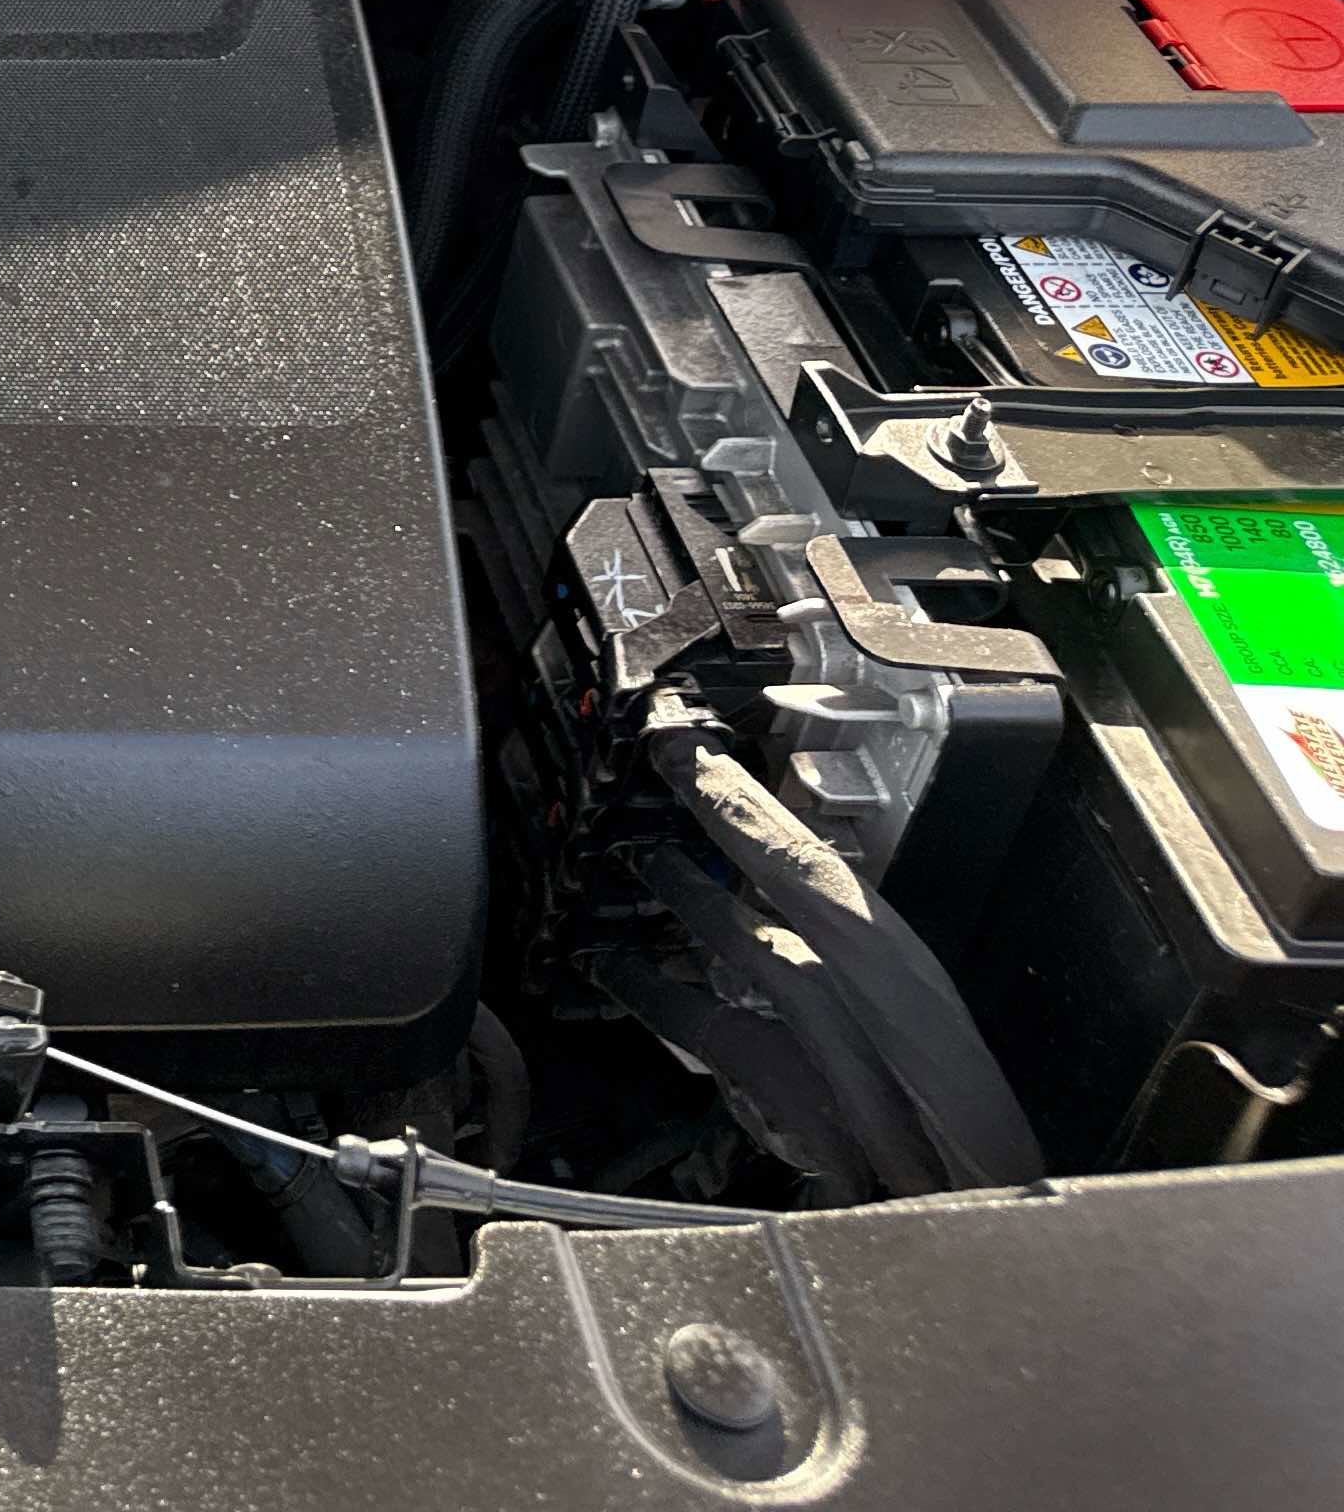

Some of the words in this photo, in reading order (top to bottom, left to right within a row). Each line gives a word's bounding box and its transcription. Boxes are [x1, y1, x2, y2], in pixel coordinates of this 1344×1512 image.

[1233, 343, 1264, 371] Return
[1158, 513, 1179, 535] AGM
[1180, 514, 1213, 544] 850
[1209, 516, 1246, 552] 1000
[1237, 517, 1266, 543] 140
[1264, 519, 1291, 539] 80
[1229, 632, 1263, 673] GROUP
